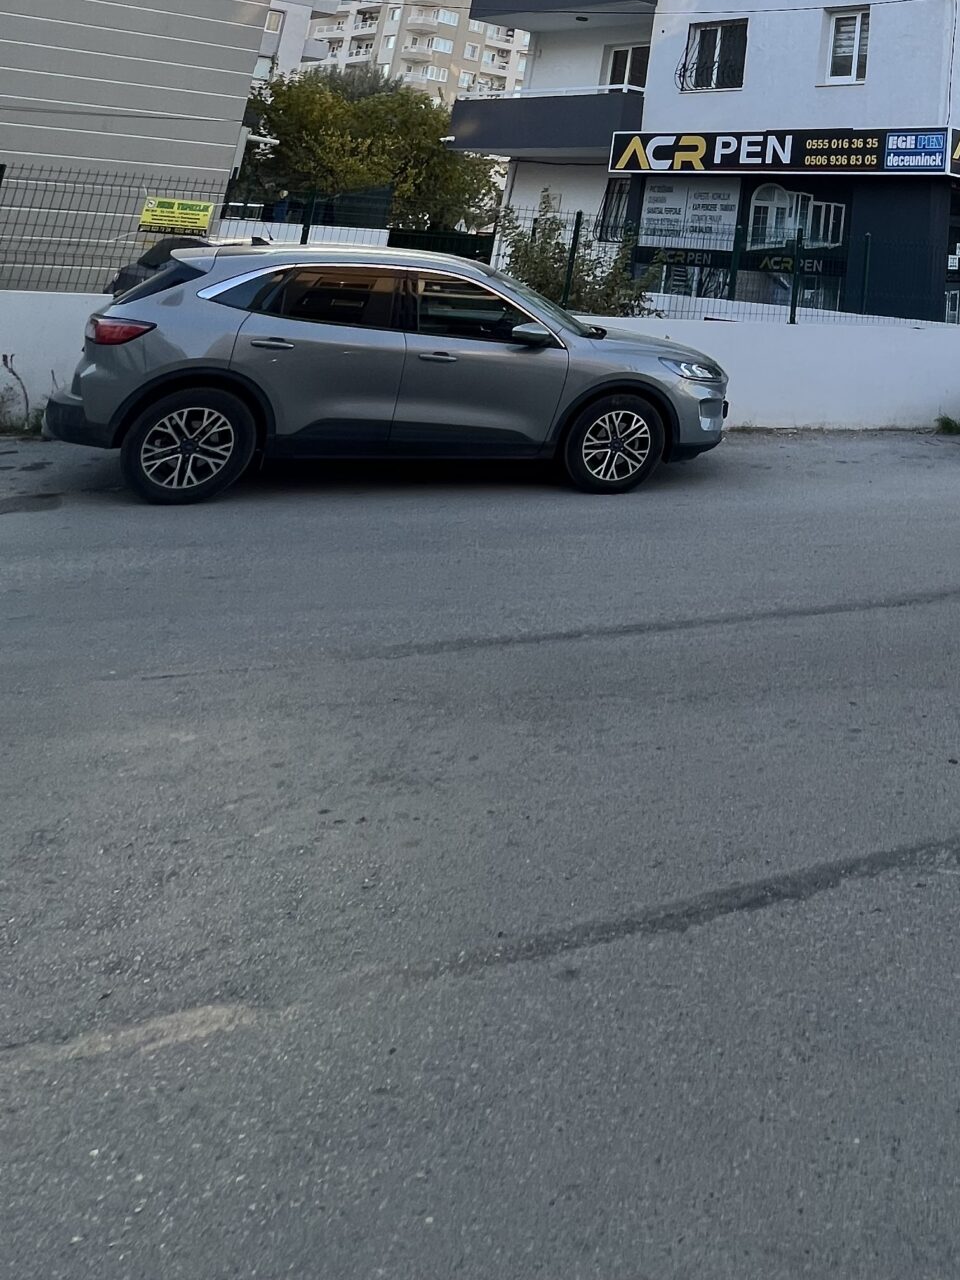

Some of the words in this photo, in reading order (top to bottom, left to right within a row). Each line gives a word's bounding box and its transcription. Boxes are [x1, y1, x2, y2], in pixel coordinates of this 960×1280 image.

[806, 139, 829, 149] 0555
[831, 139, 849, 148] 016
[851, 138, 864, 148] 36
[866, 138, 879, 148] 35
[888, 136, 916, 149] EGE
[917, 135, 944, 148] PEN
[615, 135, 706, 170] ACR
[713, 135, 792, 164] PEN
[887, 152, 942, 166] deceuninck
[804, 155, 828, 165] 0506
[829, 155, 848, 165] 936
[850, 155, 862, 165] 83
[864, 155, 877, 165] 05
[686, 252, 712, 265] PEN
[759, 256, 793, 270] ACR
